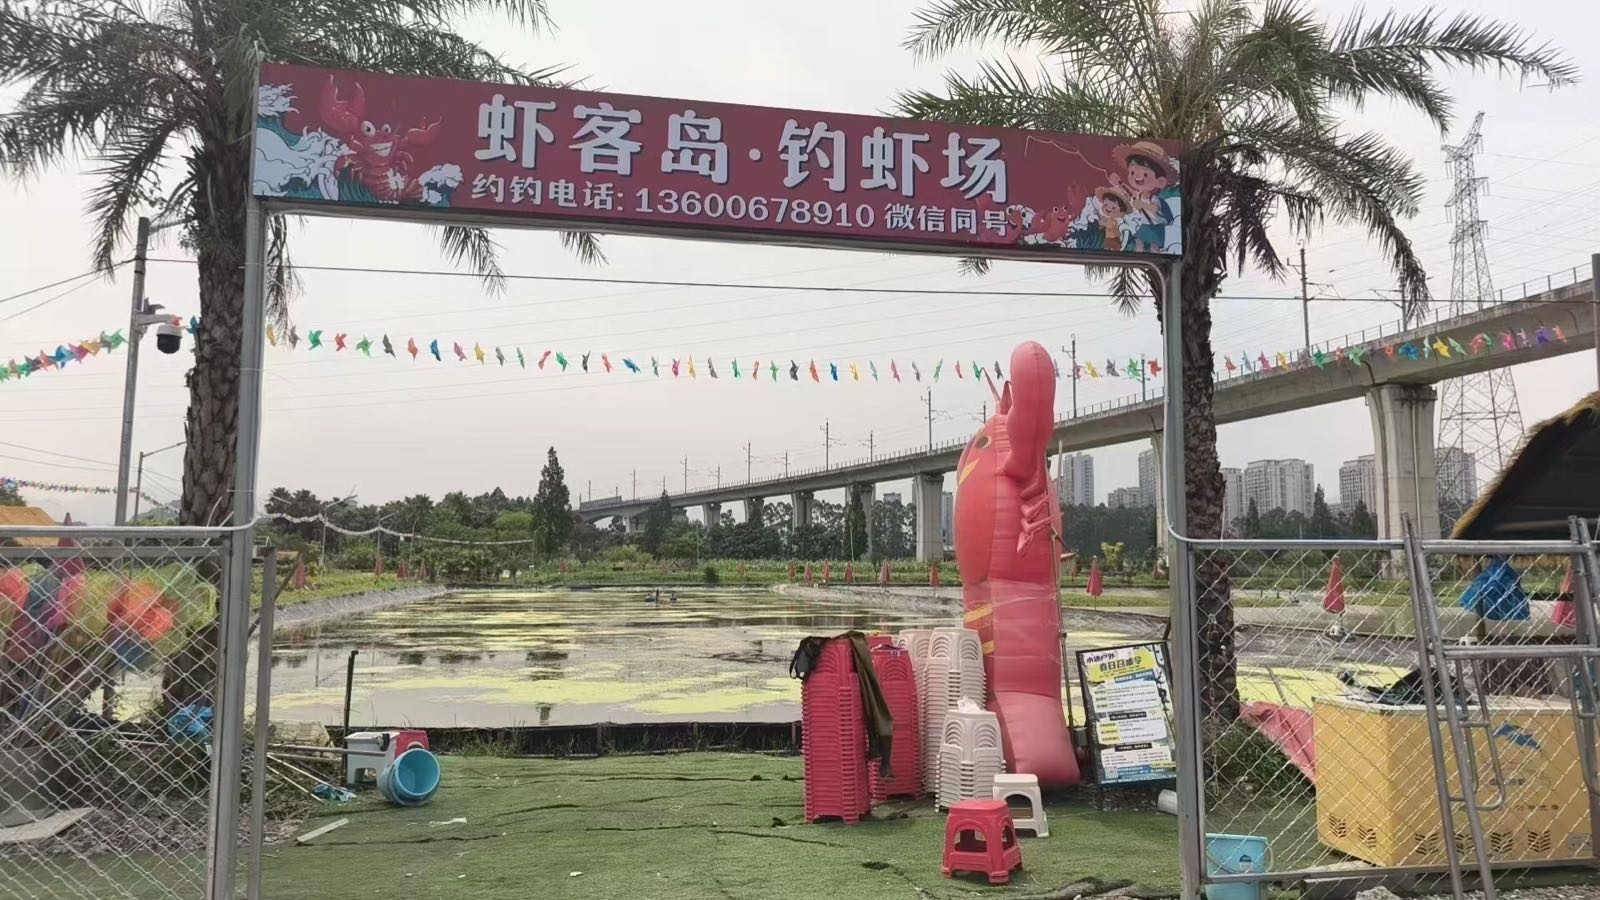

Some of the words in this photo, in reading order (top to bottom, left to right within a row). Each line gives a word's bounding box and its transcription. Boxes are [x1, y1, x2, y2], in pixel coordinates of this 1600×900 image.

[475, 93, 1007, 203] 虾客岛·钓虾场
[635, 187, 875, 228] 13600678910
[884, 203, 1009, 237] 微信同号
